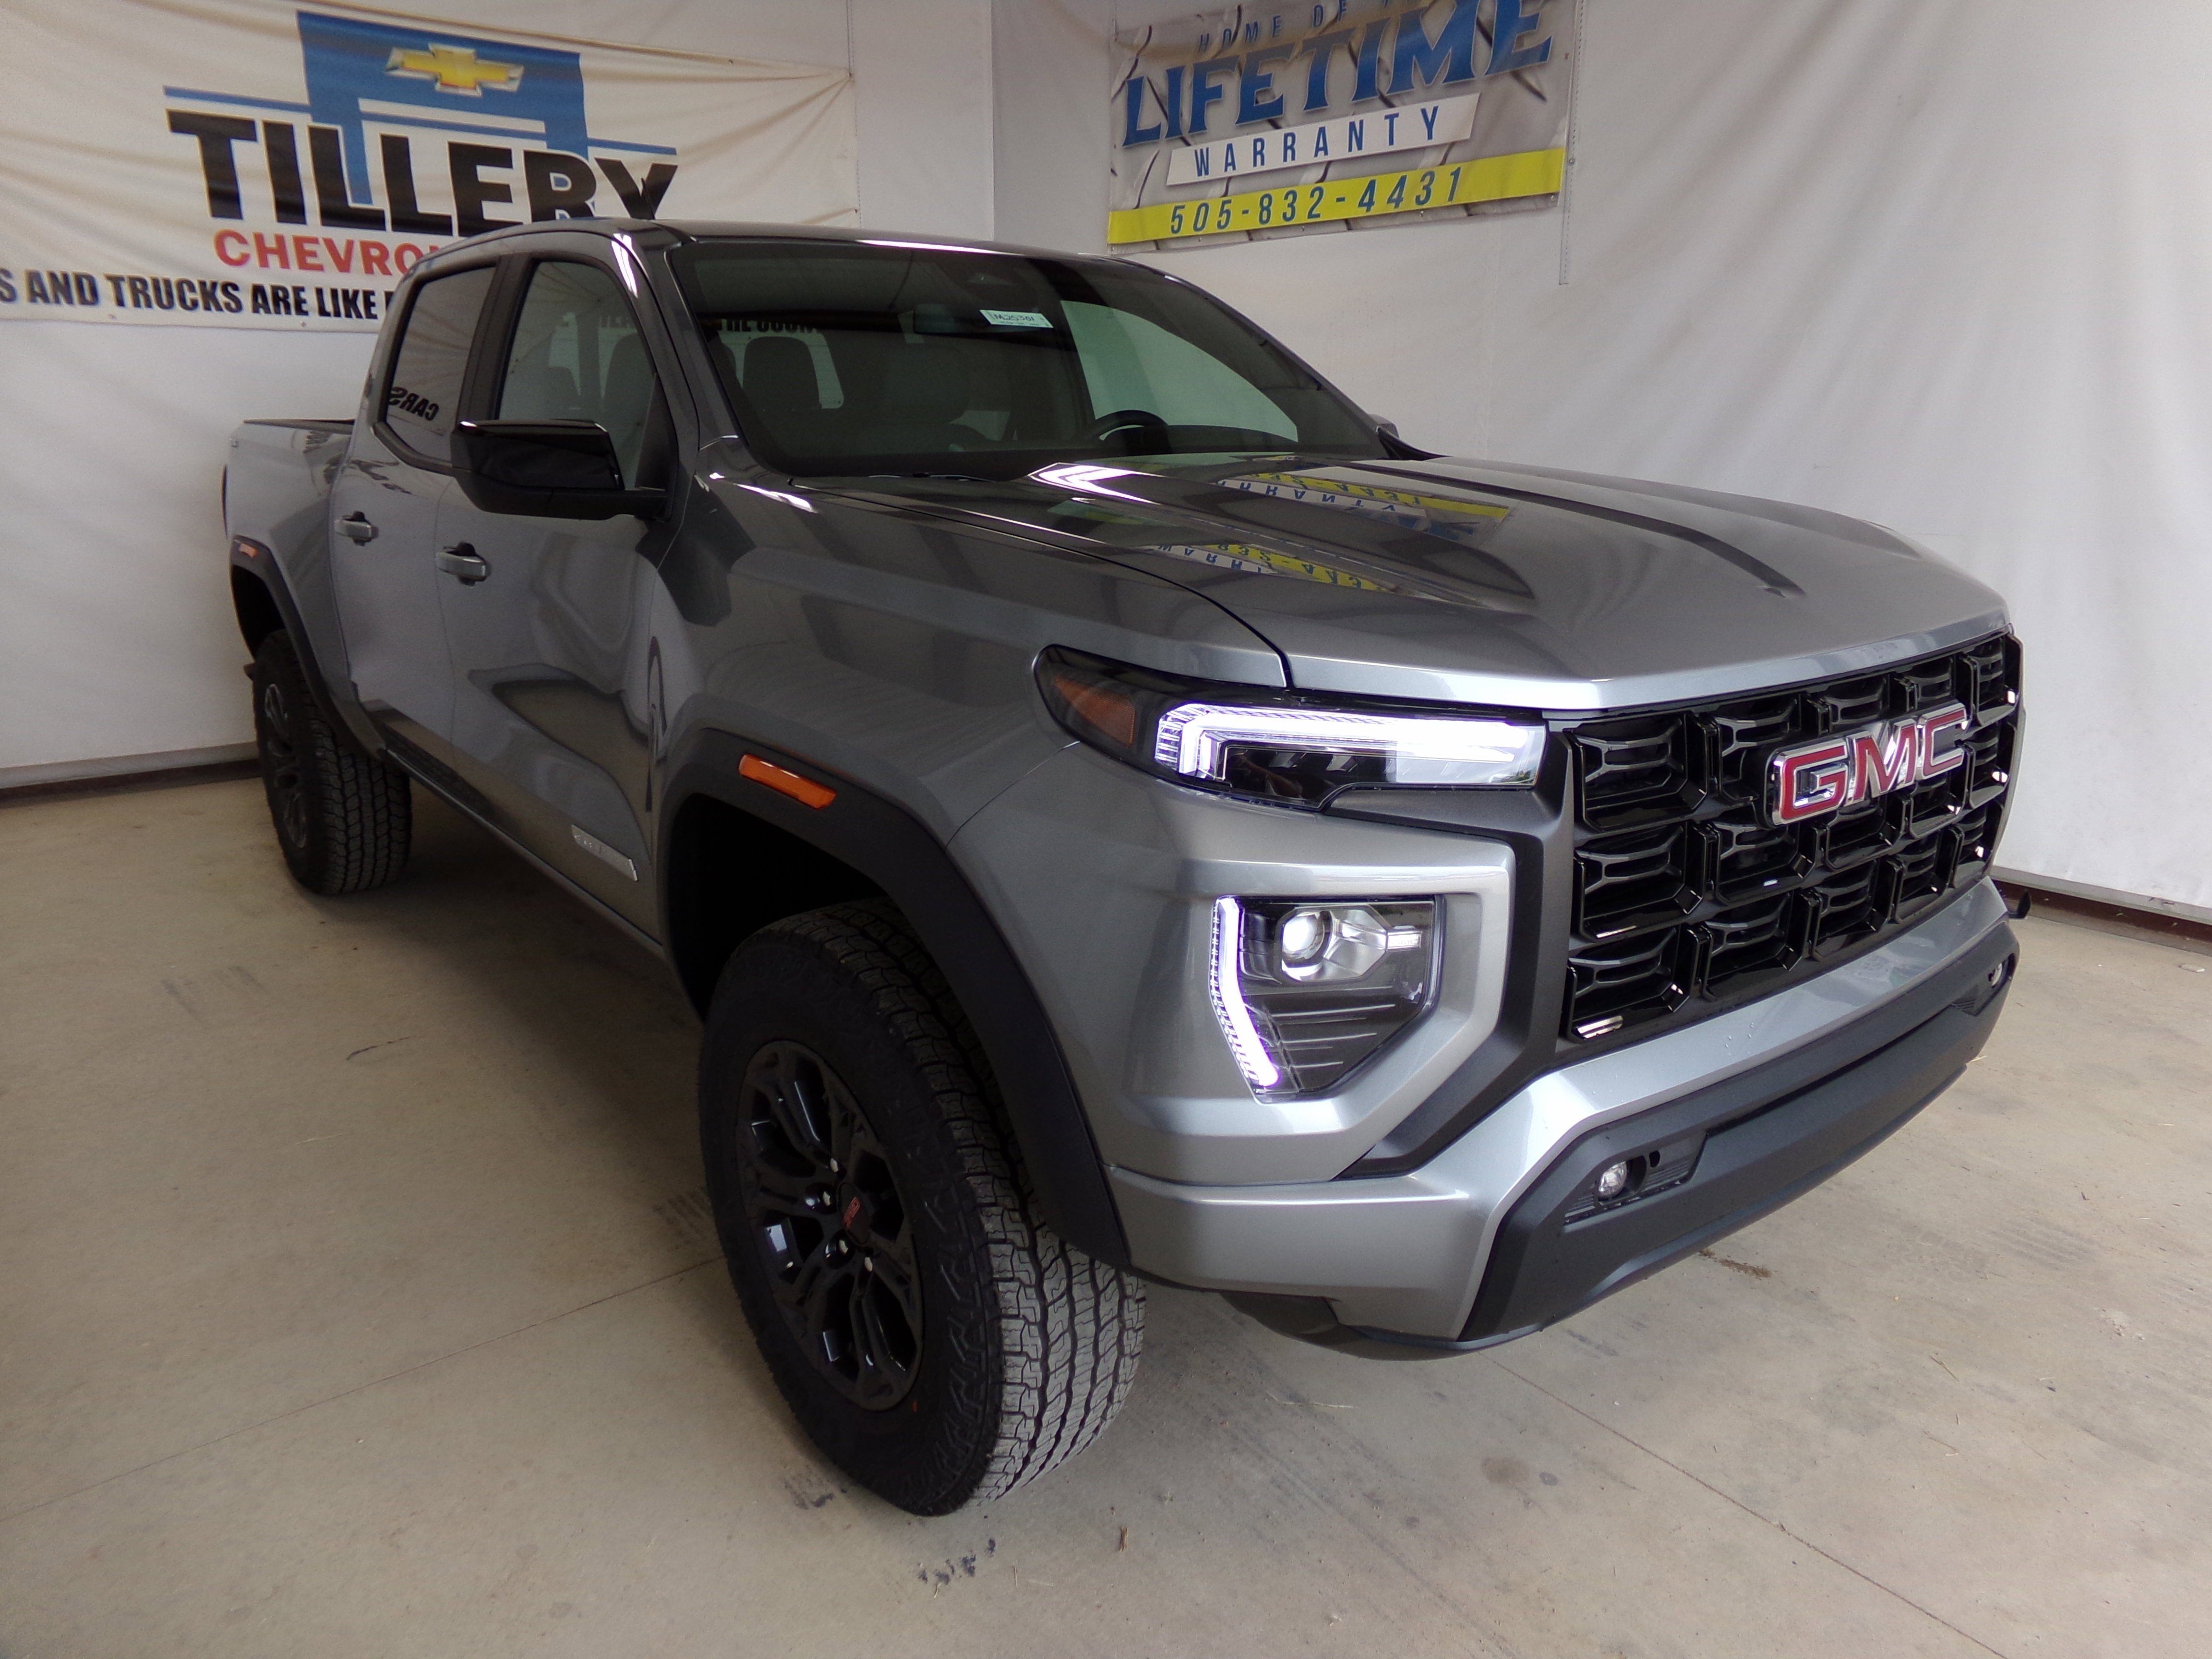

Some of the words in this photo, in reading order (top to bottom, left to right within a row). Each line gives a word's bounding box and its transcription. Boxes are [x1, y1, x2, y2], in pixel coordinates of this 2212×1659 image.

[1198, 14, 1281, 53] HOME
[1312, 0, 1347, 28] OF
[1122, 0, 1553, 147] LIFETIME
[166, 108, 678, 236] TILLERY
[1194, 105, 1442, 177] WARRANTY
[1169, 166, 1462, 234] 505-832-4431
[214, 229, 439, 276] CHEVRO
[26, 270, 99, 305] AND
[106, 275, 243, 313] TRUCKS
[251, 285, 309, 317] ARE
[318, 289, 378, 320] LIKE
[1772, 702, 1967, 825] GMC
